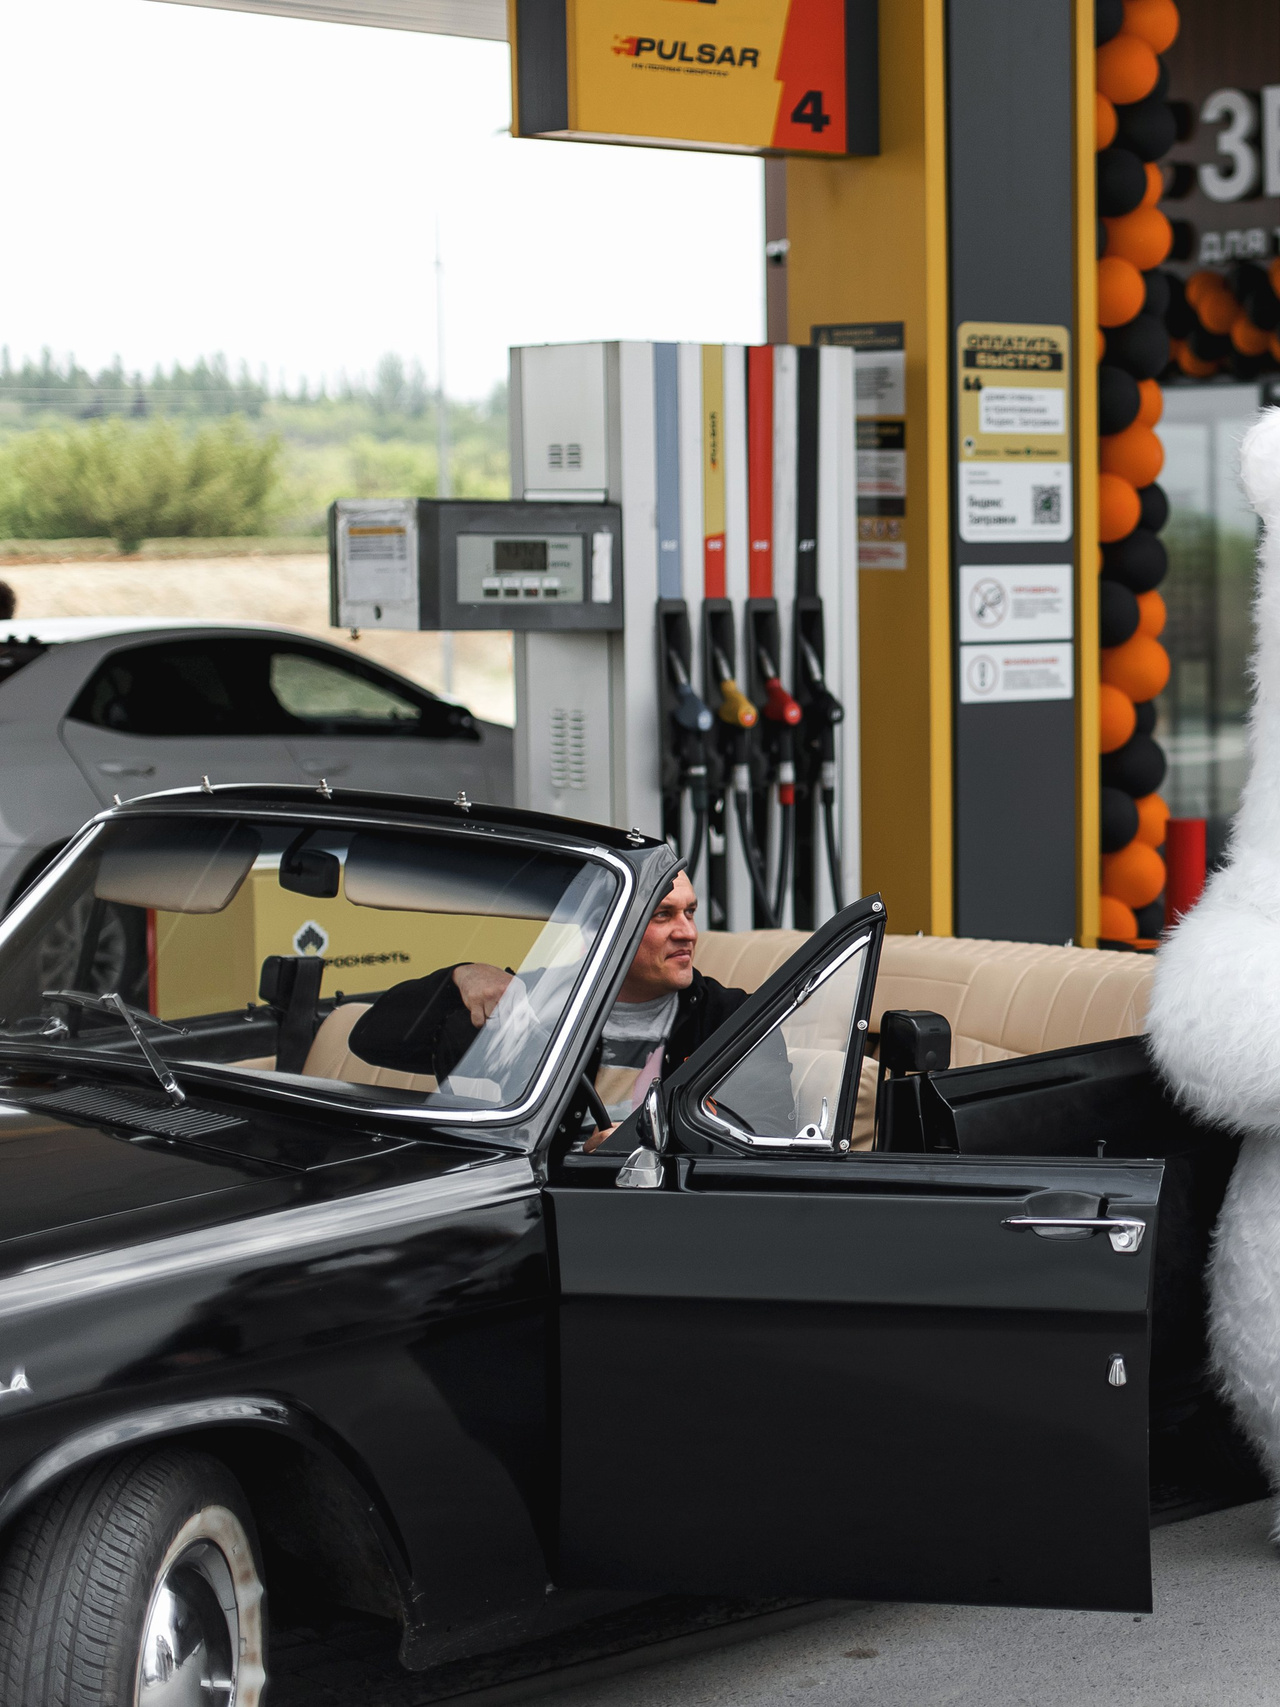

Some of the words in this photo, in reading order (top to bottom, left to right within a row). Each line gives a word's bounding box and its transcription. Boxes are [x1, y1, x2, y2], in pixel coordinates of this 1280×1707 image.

[634, 37, 760, 68] PULSAR
[791, 90, 831, 133] 4
[1199, 228, 1267, 264] ДЛЯ
